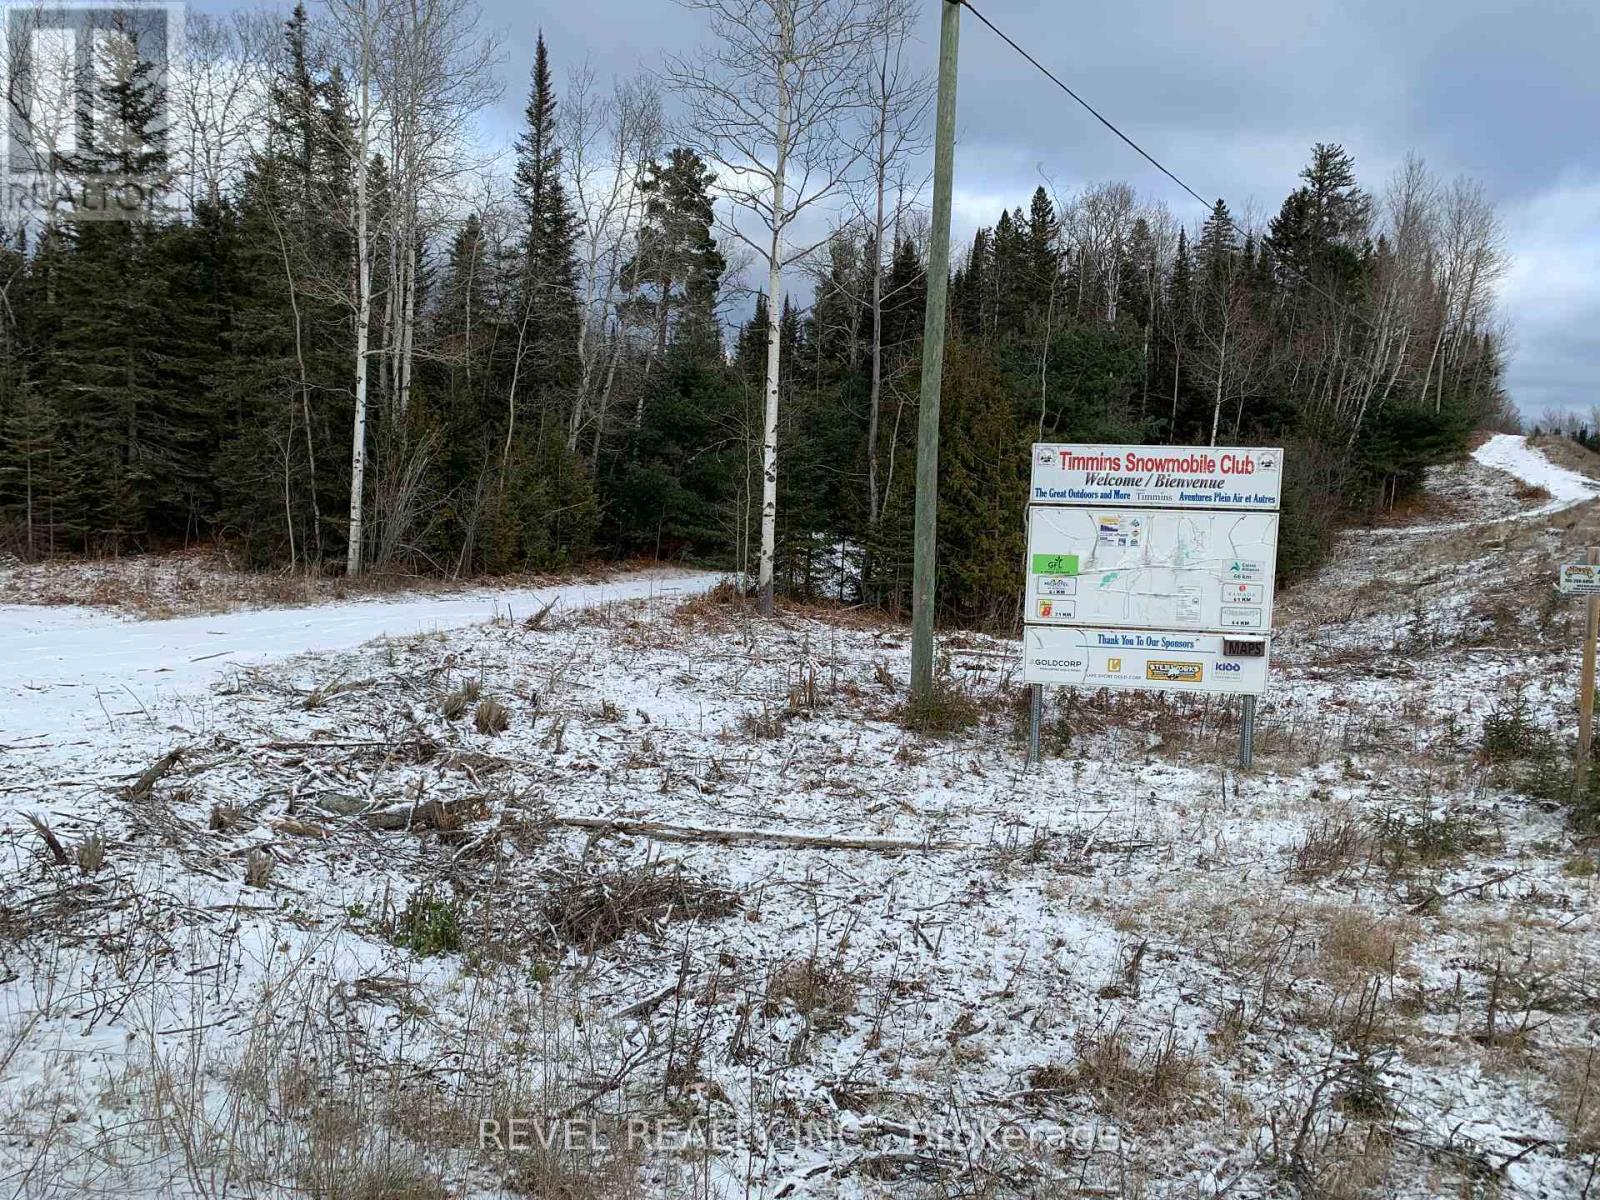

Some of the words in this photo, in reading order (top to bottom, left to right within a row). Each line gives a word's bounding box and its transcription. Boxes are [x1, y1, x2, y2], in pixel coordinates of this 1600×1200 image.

[1059, 451, 1121, 471] Timmins
[1125, 452, 1215, 474] Snowmobile
[1220, 454, 1255, 475] Club
[1085, 472, 1144, 487] Welcome
[1154, 474, 1226, 489] Bienvenue
[1035, 488, 1048, 498] The
[1049, 488, 1067, 498] Great
[1068, 488, 1098, 499] Outdoors
[1099, 489, 1112, 499] and
[1113, 490, 1131, 500] More
[1136, 492, 1173, 501] Timmins
[1179, 492, 1212, 502] Aventures
[1213, 492, 1231, 502] Plein
[1232, 493, 1244, 503] Air
[1245, 494, 1252, 503] et
[1253, 494, 1276, 504] Autres
[1097, 633, 1120, 645] Thank
[1120, 635, 1134, 646] You
[1136, 635, 1144, 647] To
[1146, 636, 1160, 647] Our
[1161, 636, 1195, 649] Sponsors
[1228, 640, 1261, 655] MAPS
[1034, 658, 1082, 668] GOLDCORP
